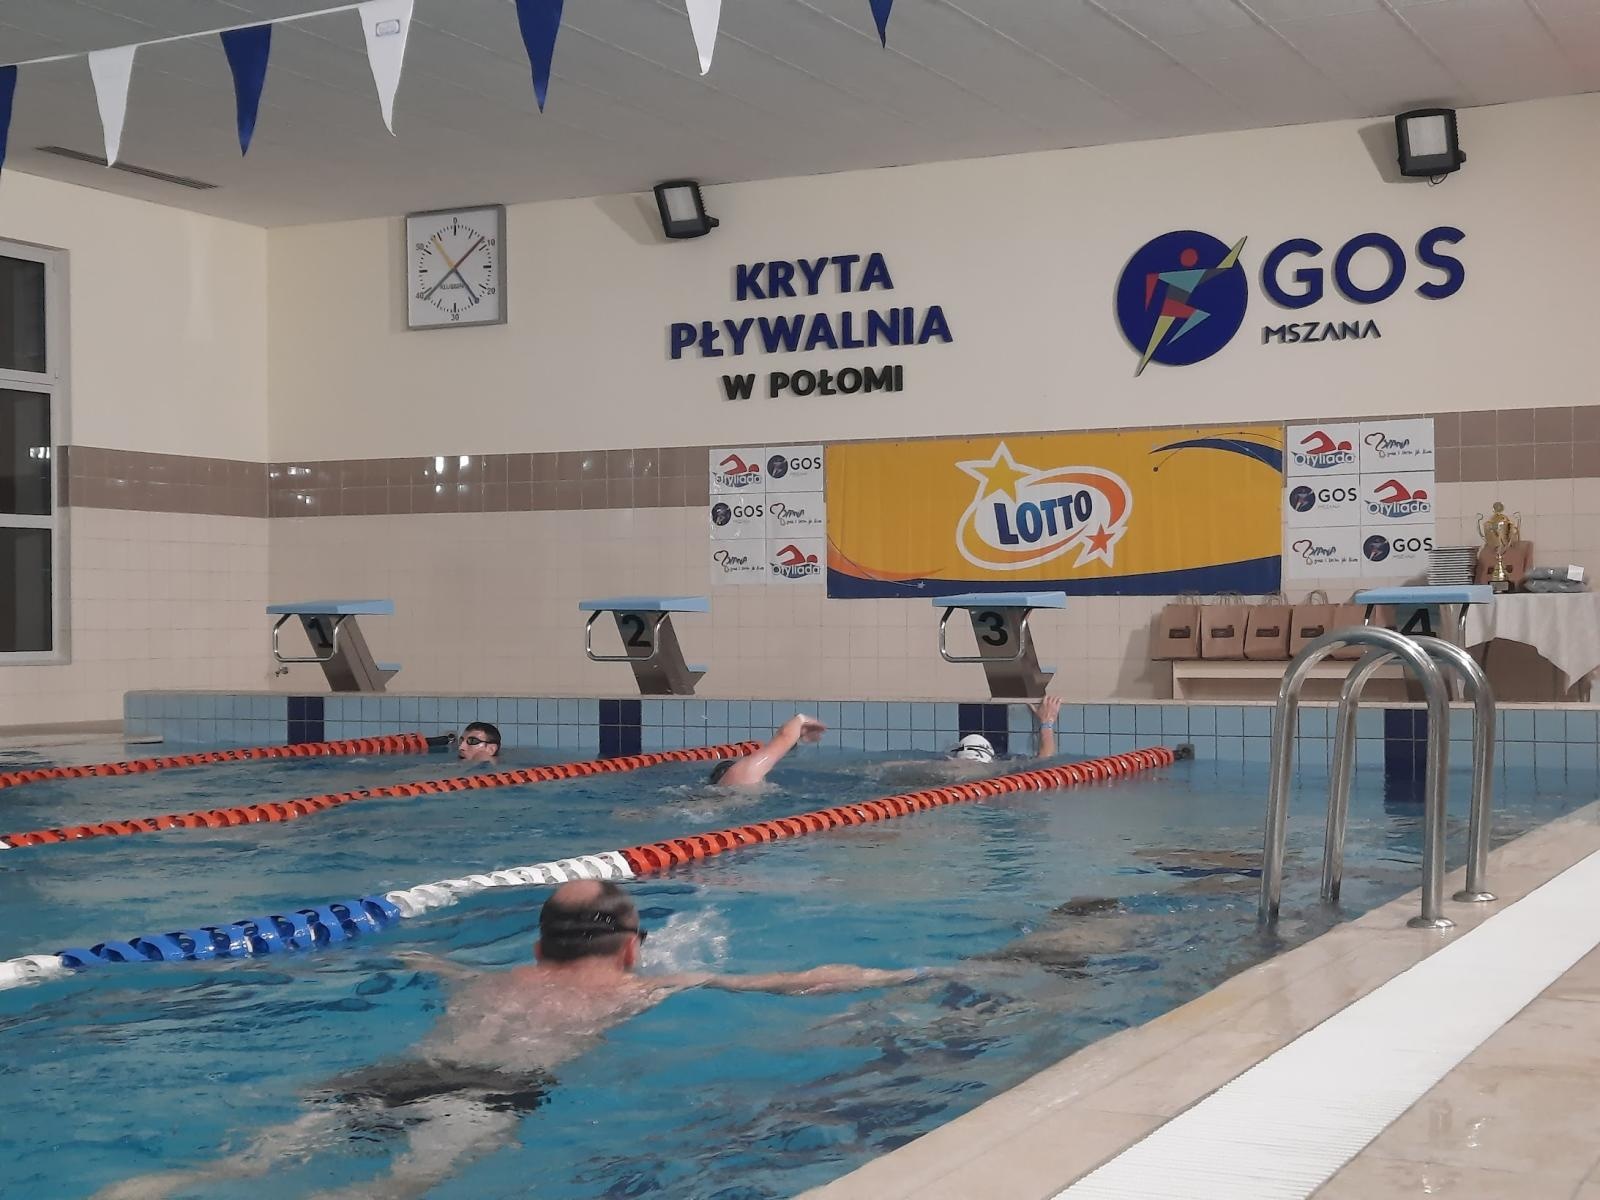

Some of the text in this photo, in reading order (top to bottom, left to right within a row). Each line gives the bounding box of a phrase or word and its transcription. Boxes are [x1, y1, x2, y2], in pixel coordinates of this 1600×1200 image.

[487, 239, 496, 247] 10
[736, 252, 895, 301] KRYTA
[1261, 226, 1466, 310] GOS
[487, 287, 496, 296] 20
[450, 313, 460, 321] 30
[1263, 319, 1382, 344] MSZANA
[670, 305, 953, 360] PŁYWALNIA
[722, 364, 904, 400] W POŁOMI
[790, 457, 822, 470] GOS
[1318, 487, 1357, 502] GOS
[733, 505, 764, 518] GOS
[993, 490, 1093, 546] LOTTO
[1392, 537, 1433, 553] GOS
[307, 618, 334, 648] 1
[621, 614, 651, 648] 2
[978, 611, 1009, 646] 3
[1401, 608, 1437, 638] 4
